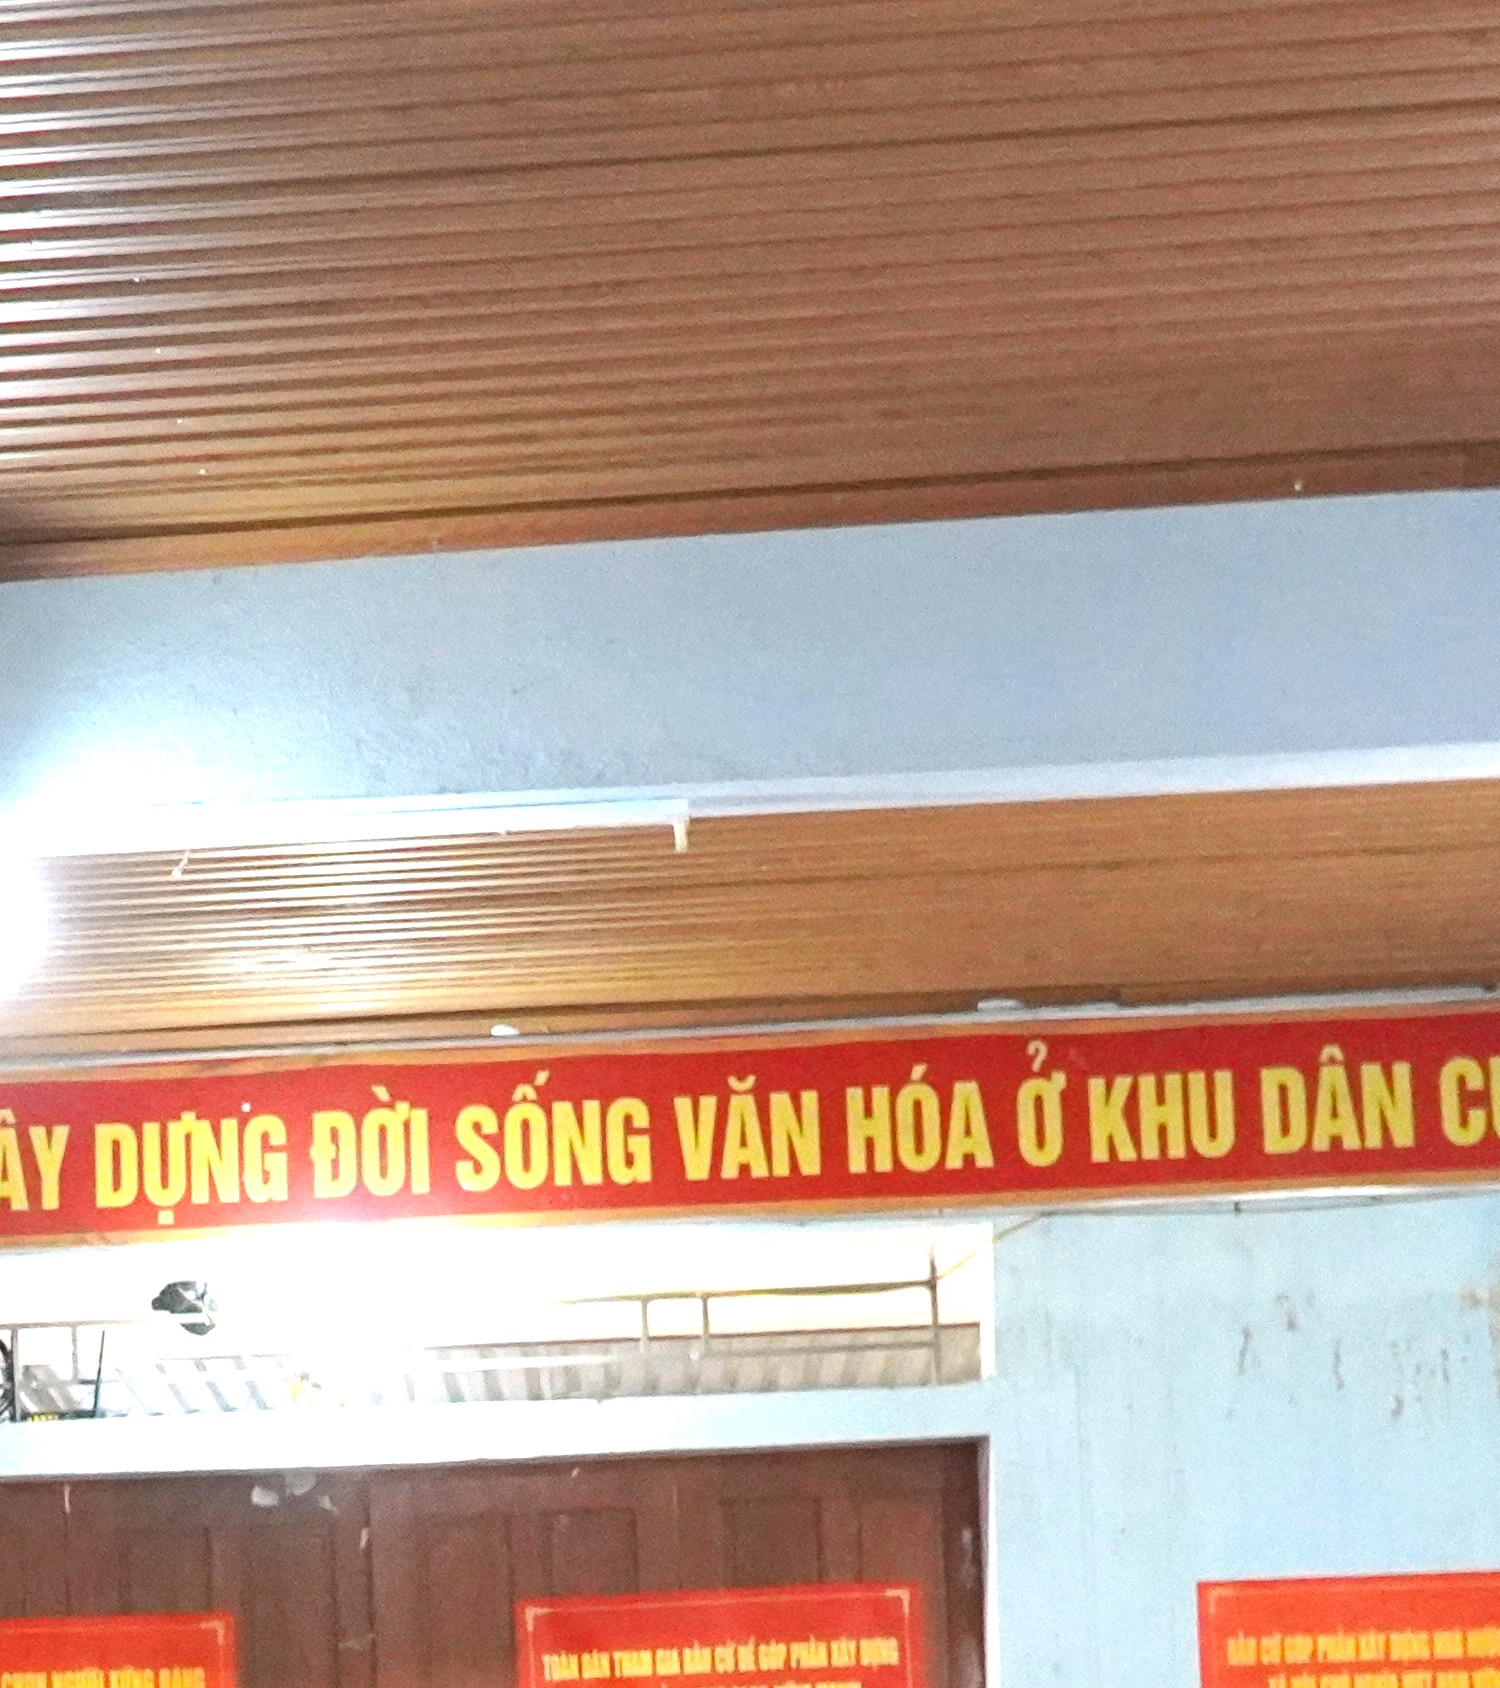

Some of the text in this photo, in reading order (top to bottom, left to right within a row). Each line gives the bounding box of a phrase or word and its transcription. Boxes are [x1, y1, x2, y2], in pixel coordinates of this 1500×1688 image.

[94, 1110, 288, 1225] DỰNG
[310, 1086, 429, 1199] ĐỜI
[455, 1070, 651, 1193] SỐNG
[674, 1076, 822, 1181] VĂN
[845, 1065, 994, 1175] HÓA
[1016, 1040, 1068, 1168] Ở
[1088, 1066, 1236, 1163] KHU
[1261, 1045, 1415, 1156] DÂN
